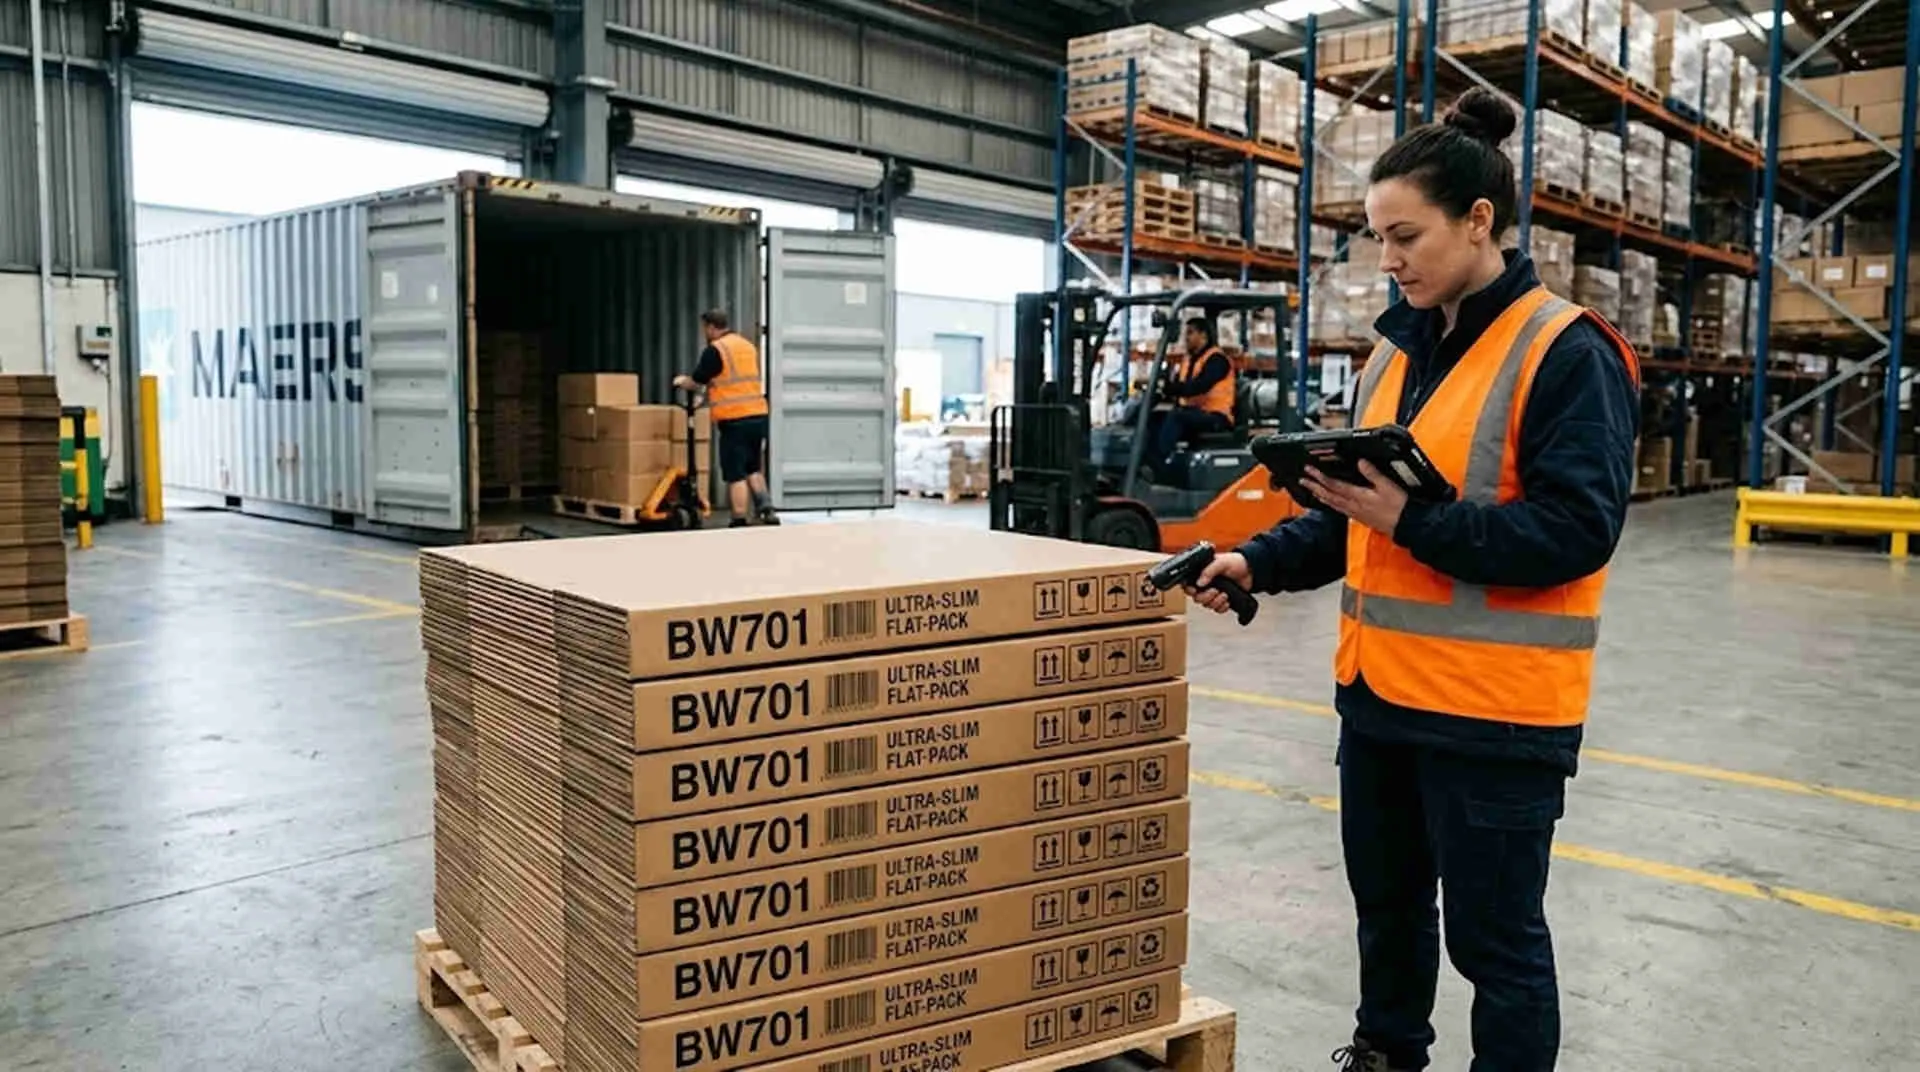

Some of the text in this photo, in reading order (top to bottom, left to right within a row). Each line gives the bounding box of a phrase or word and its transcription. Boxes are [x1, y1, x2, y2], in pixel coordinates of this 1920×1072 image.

[886, 590, 979, 615] ULTRA-SLIM
[668, 608, 808, 661] BW701
[886, 612, 968, 637] FLAT-PACK
[888, 657, 979, 685] ULTRA-SLIM
[671, 679, 810, 734] BW701
[888, 679, 969, 705] FLAT-PACK
[887, 721, 979, 749] ULTRA-SLIM
[887, 742, 968, 770] FLAT-PACK
[671, 746, 810, 803] BW701
[886, 785, 979, 815] ULTRA-SLIM
[886, 806, 968, 834] FLAT-PACK
[672, 813, 810, 870] BW701
[886, 846, 979, 877] ULTRA-SLIM
[886, 868, 967, 897] FLAT-PACK
[673, 877, 810, 936] BW701
[885, 907, 978, 940] ULTRA-SLIM
[886, 929, 967, 959] FLAT-PACK
[675, 940, 810, 1000] BW701
[884, 968, 978, 1003] ULTRA-SLIM
[885, 990, 966, 1023] FLAT-PACK
[675, 1006, 810, 1068] BW701
[879, 1030, 972, 1066] ULTRA-SLIM
